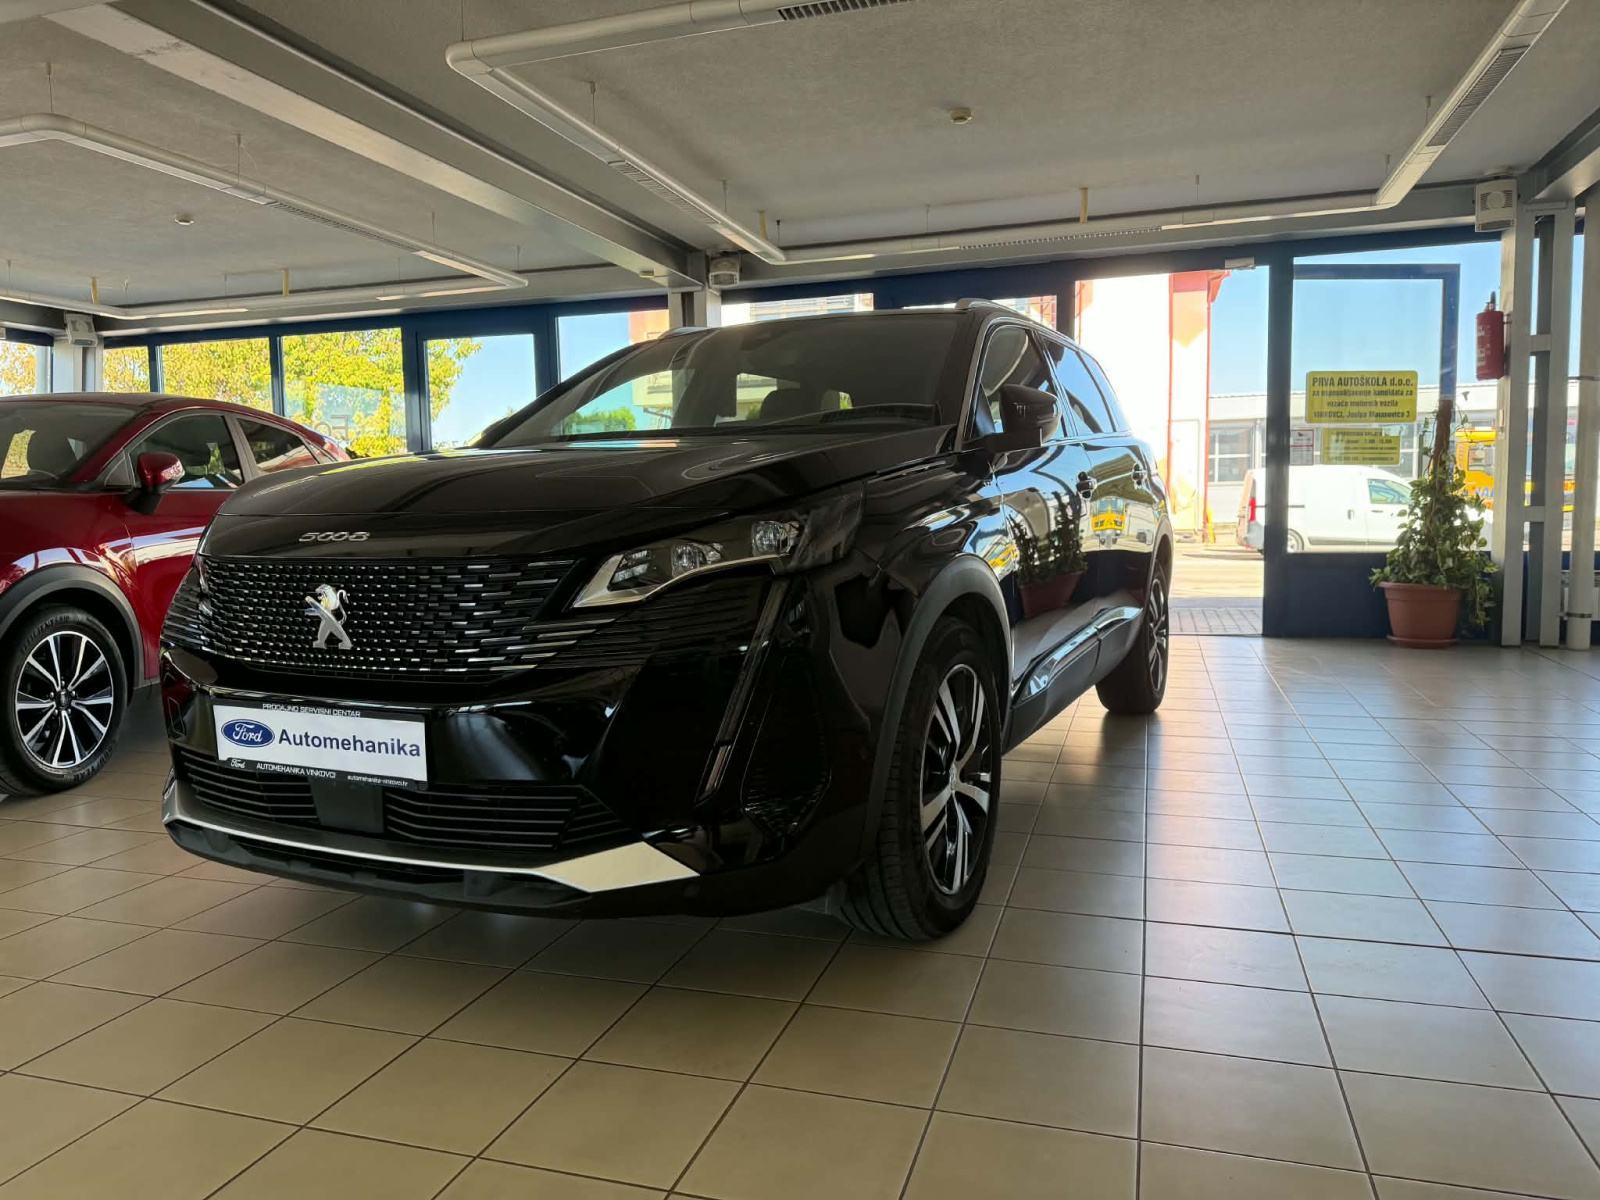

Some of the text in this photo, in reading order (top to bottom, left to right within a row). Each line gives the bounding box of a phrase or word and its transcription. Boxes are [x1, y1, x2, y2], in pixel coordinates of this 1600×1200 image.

[298, 531, 371, 542] 5008
[332, 709, 361, 718] CENTAR
[232, 722, 420, 757] Ford Automehanika
[256, 762, 305, 776] AUTOMEHANIKA
[305, 768, 337, 779] VINKOVCI
